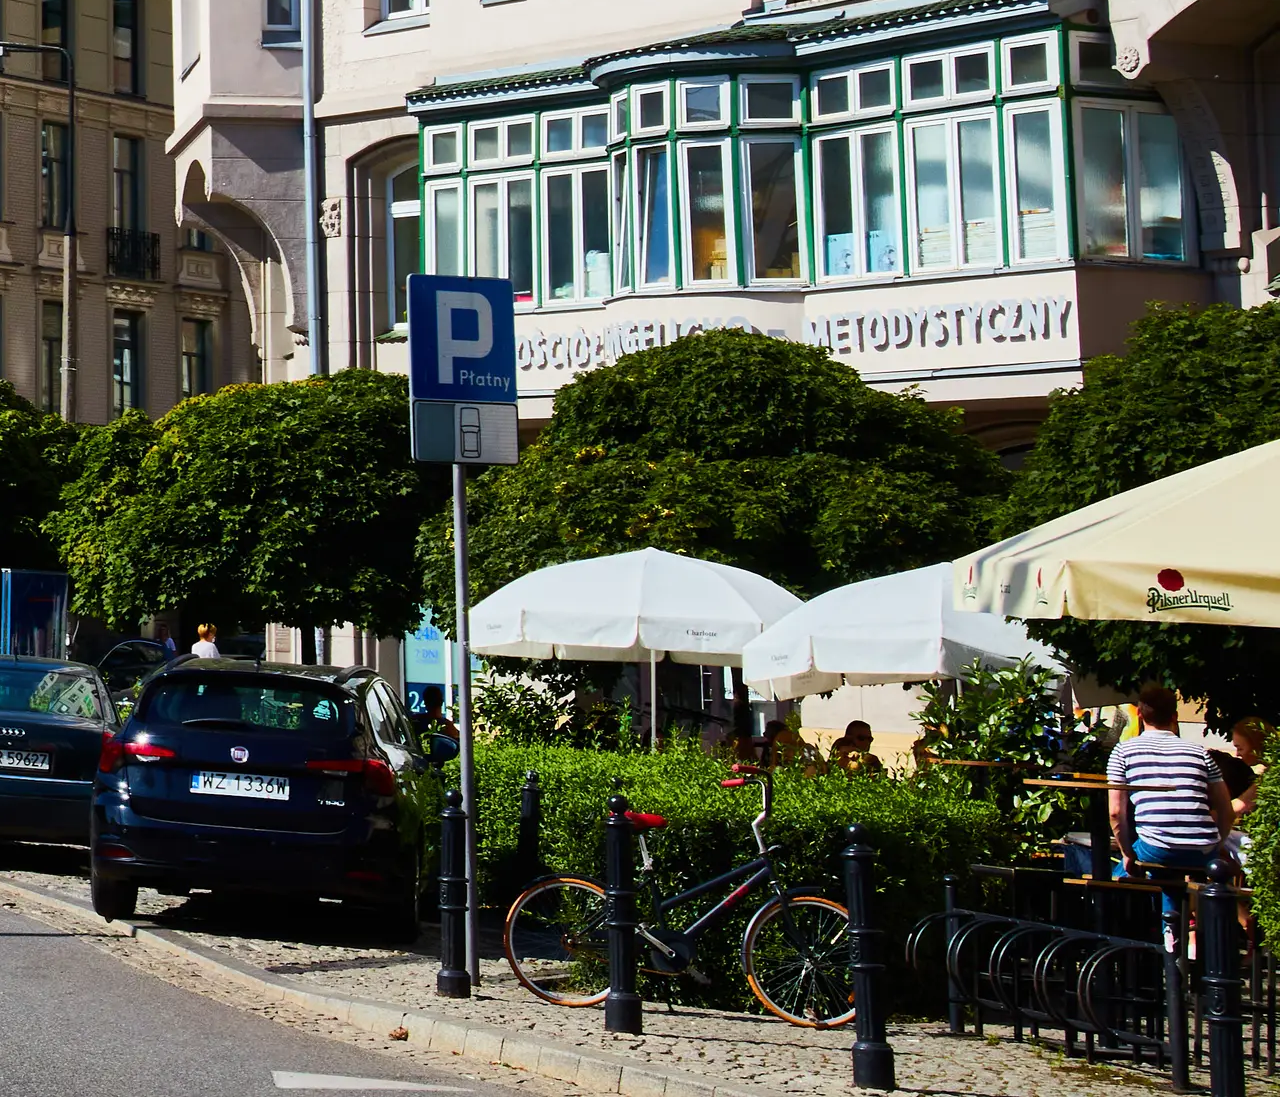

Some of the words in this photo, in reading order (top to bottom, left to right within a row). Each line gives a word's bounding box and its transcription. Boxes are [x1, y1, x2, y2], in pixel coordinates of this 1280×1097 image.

[802, 295, 1069, 353] METODYSTYCZNY
[435, 290, 494, 385] P
[459, 369, 511, 392] Płatny
[1146, 587, 1189, 614] Pilsner
[1187, 588, 1230, 611] Urquell
[686, 628, 718, 638] Charlotte
[7, 751, 48, 768] 59627
[202, 772, 226, 790] WZ
[234, 774, 287, 795] 1336W
